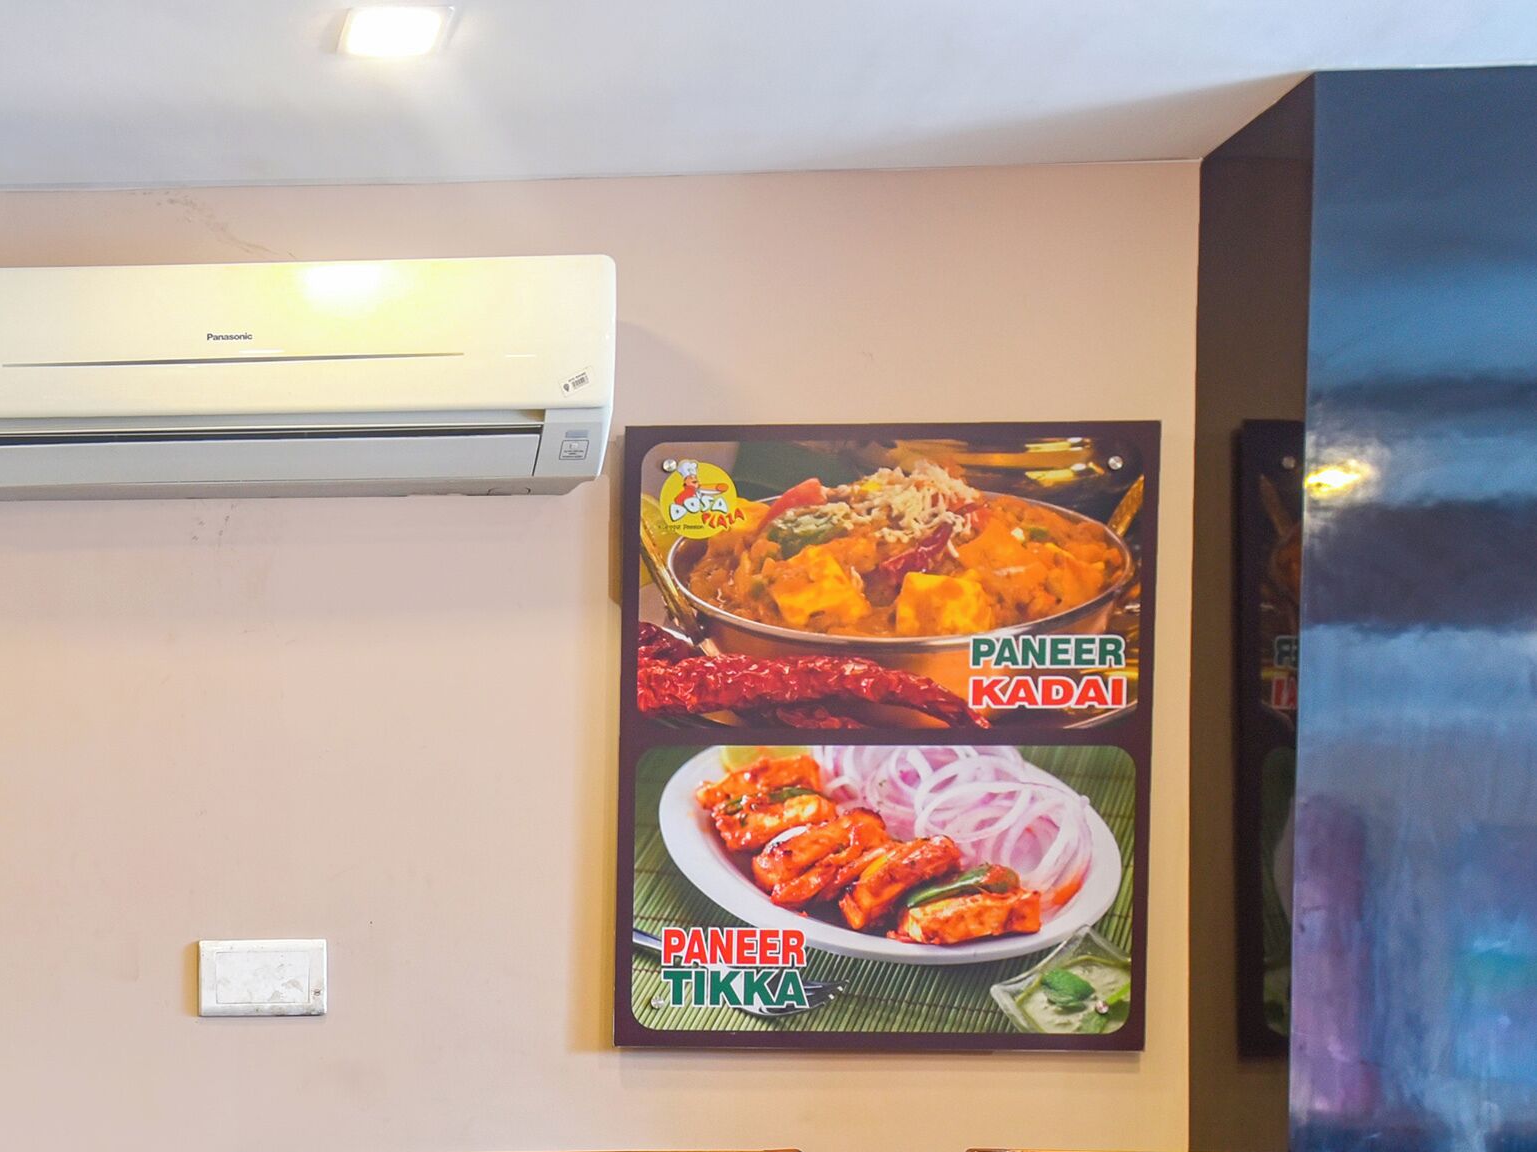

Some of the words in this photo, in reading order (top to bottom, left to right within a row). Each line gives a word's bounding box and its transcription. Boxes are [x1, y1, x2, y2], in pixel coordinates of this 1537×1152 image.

[206, 332, 253, 341] Panasonic
[669, 495, 728, 522] DOSA
[701, 507, 745, 531] PLAZA
[970, 634, 1126, 669] PANEER
[968, 675, 1127, 709] KADAI
[661, 927, 808, 968] PANEER
[661, 968, 810, 1009] TIKKA
